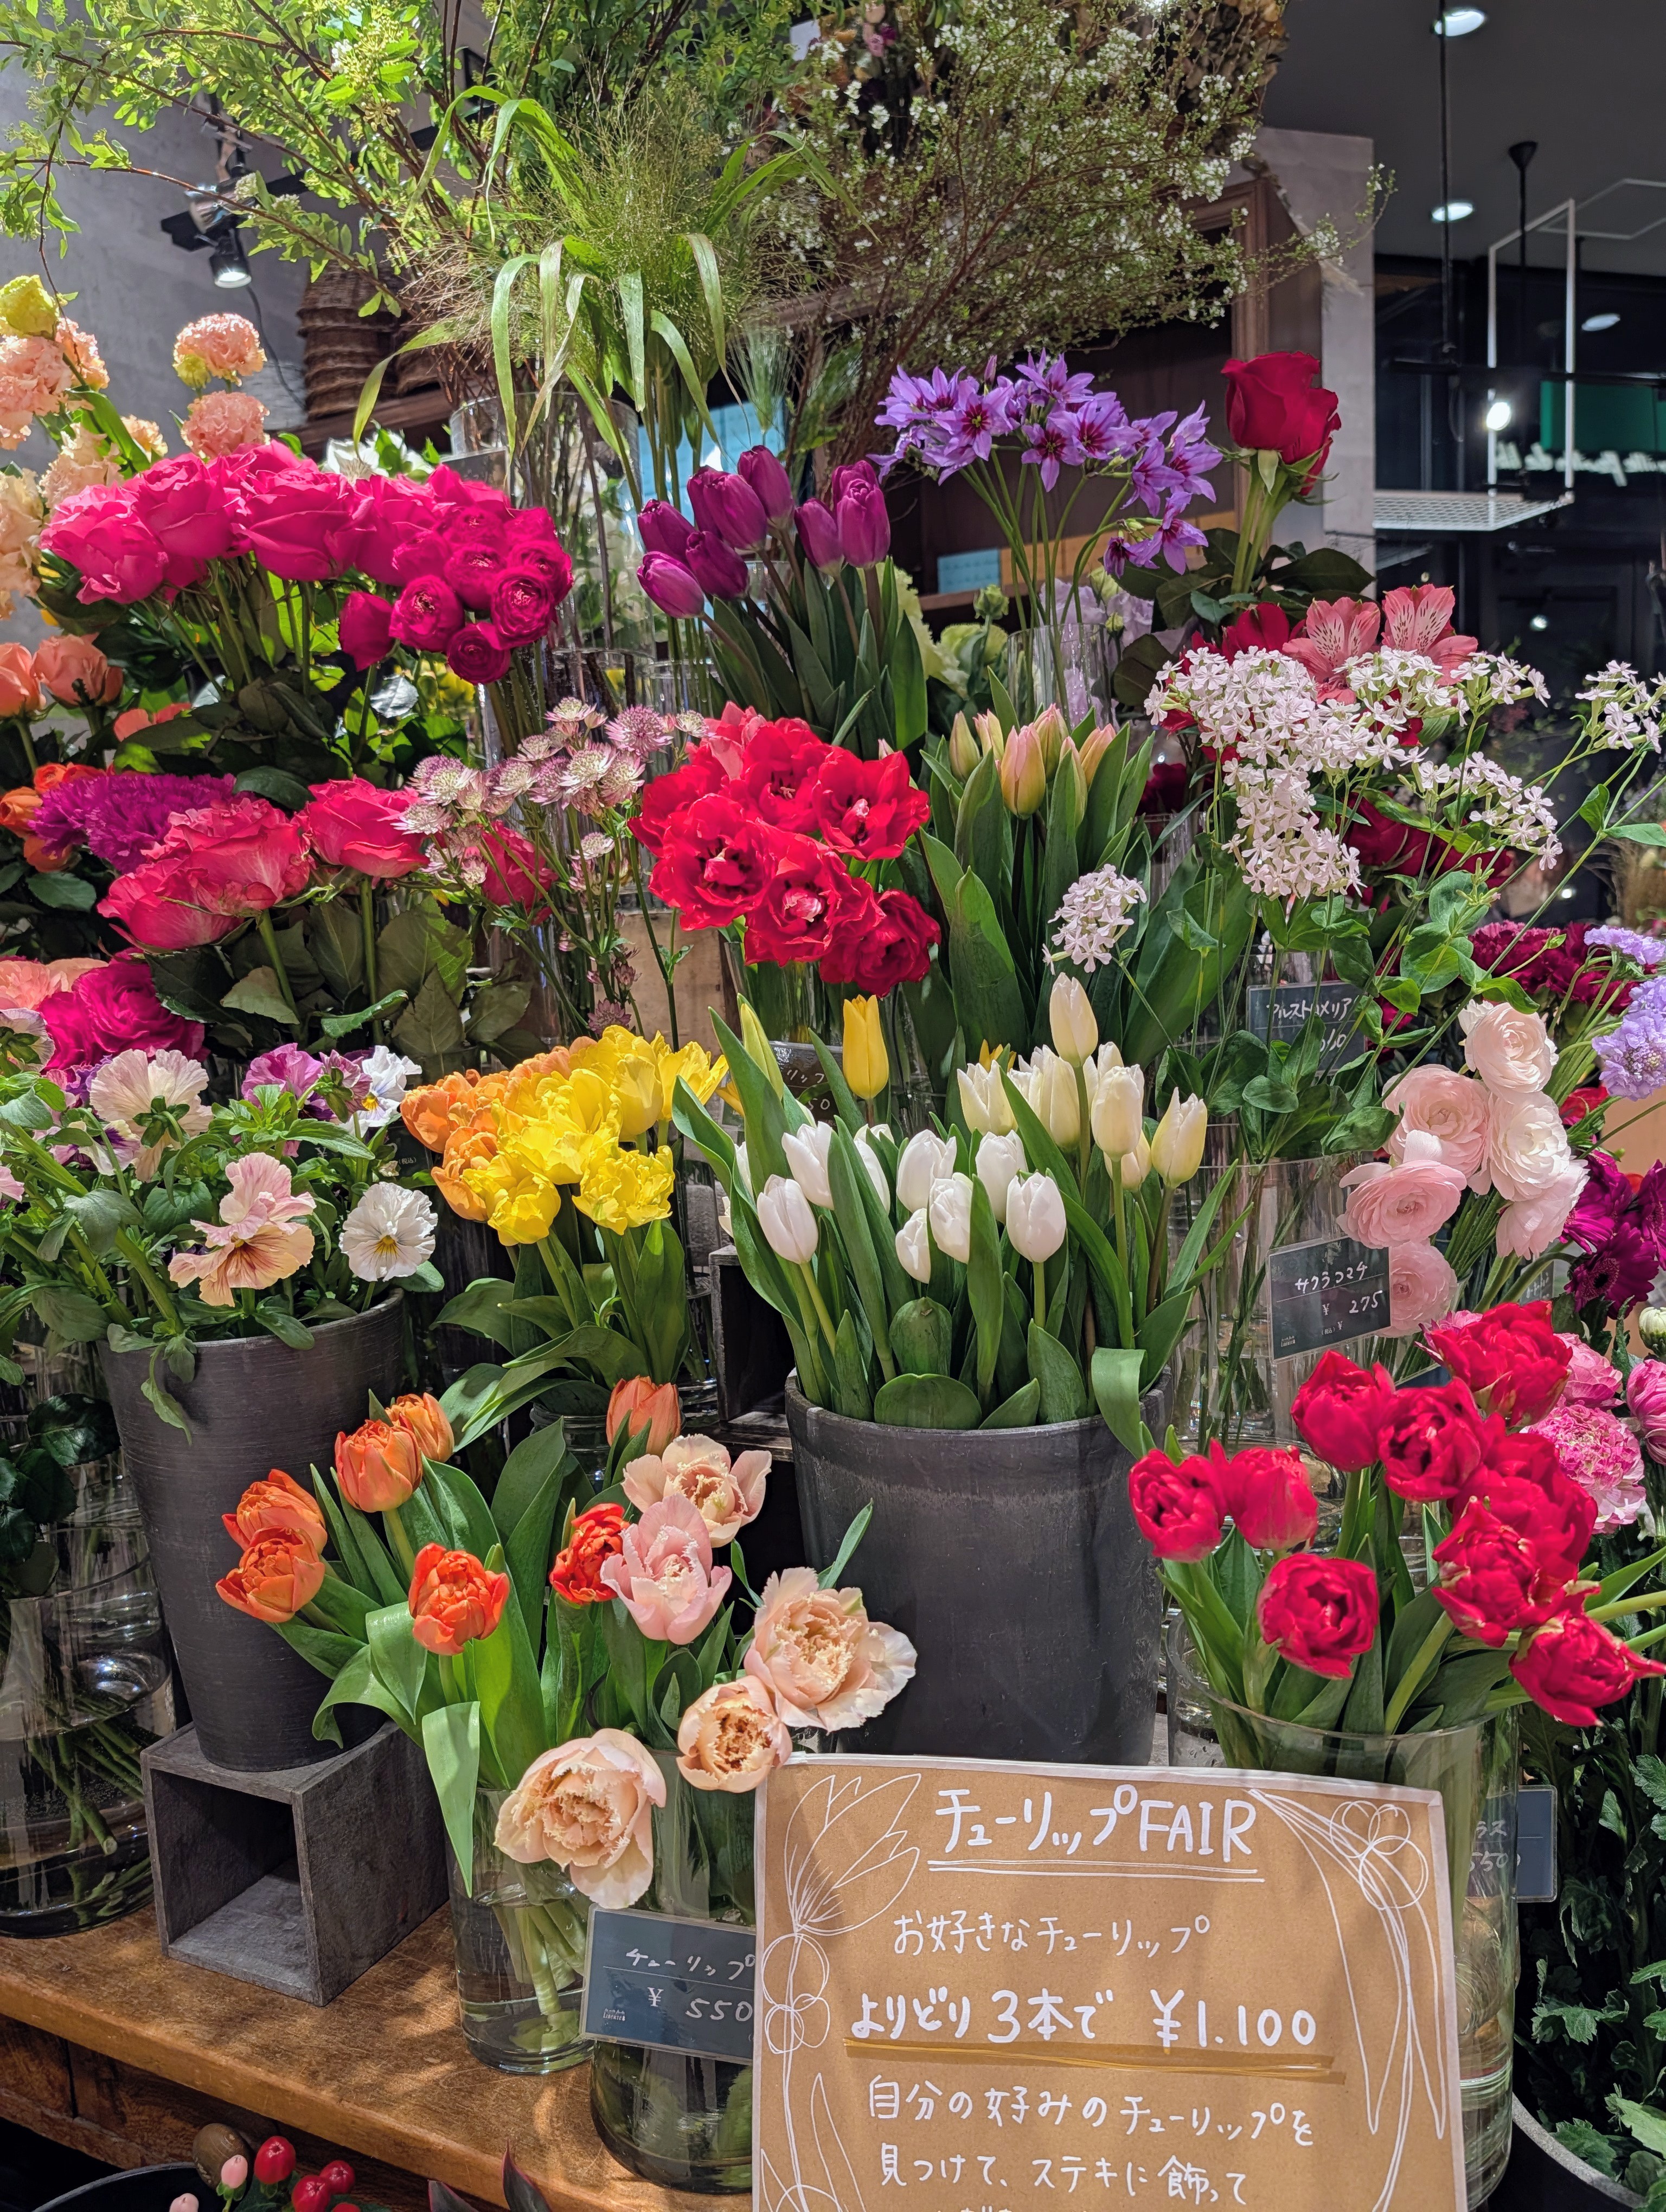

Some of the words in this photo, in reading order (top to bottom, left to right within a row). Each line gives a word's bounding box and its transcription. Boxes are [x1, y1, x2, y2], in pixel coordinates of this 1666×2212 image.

[1349, 1290, 1382, 1314] 275
[894, 1909, 1210, 1957] お好きなチューリップ
[626, 1949, 755, 1980] チューリップ
[685, 1998, 753, 2022] 550
[869, 2074, 1313, 2146] 自分の好みのチューリップを
